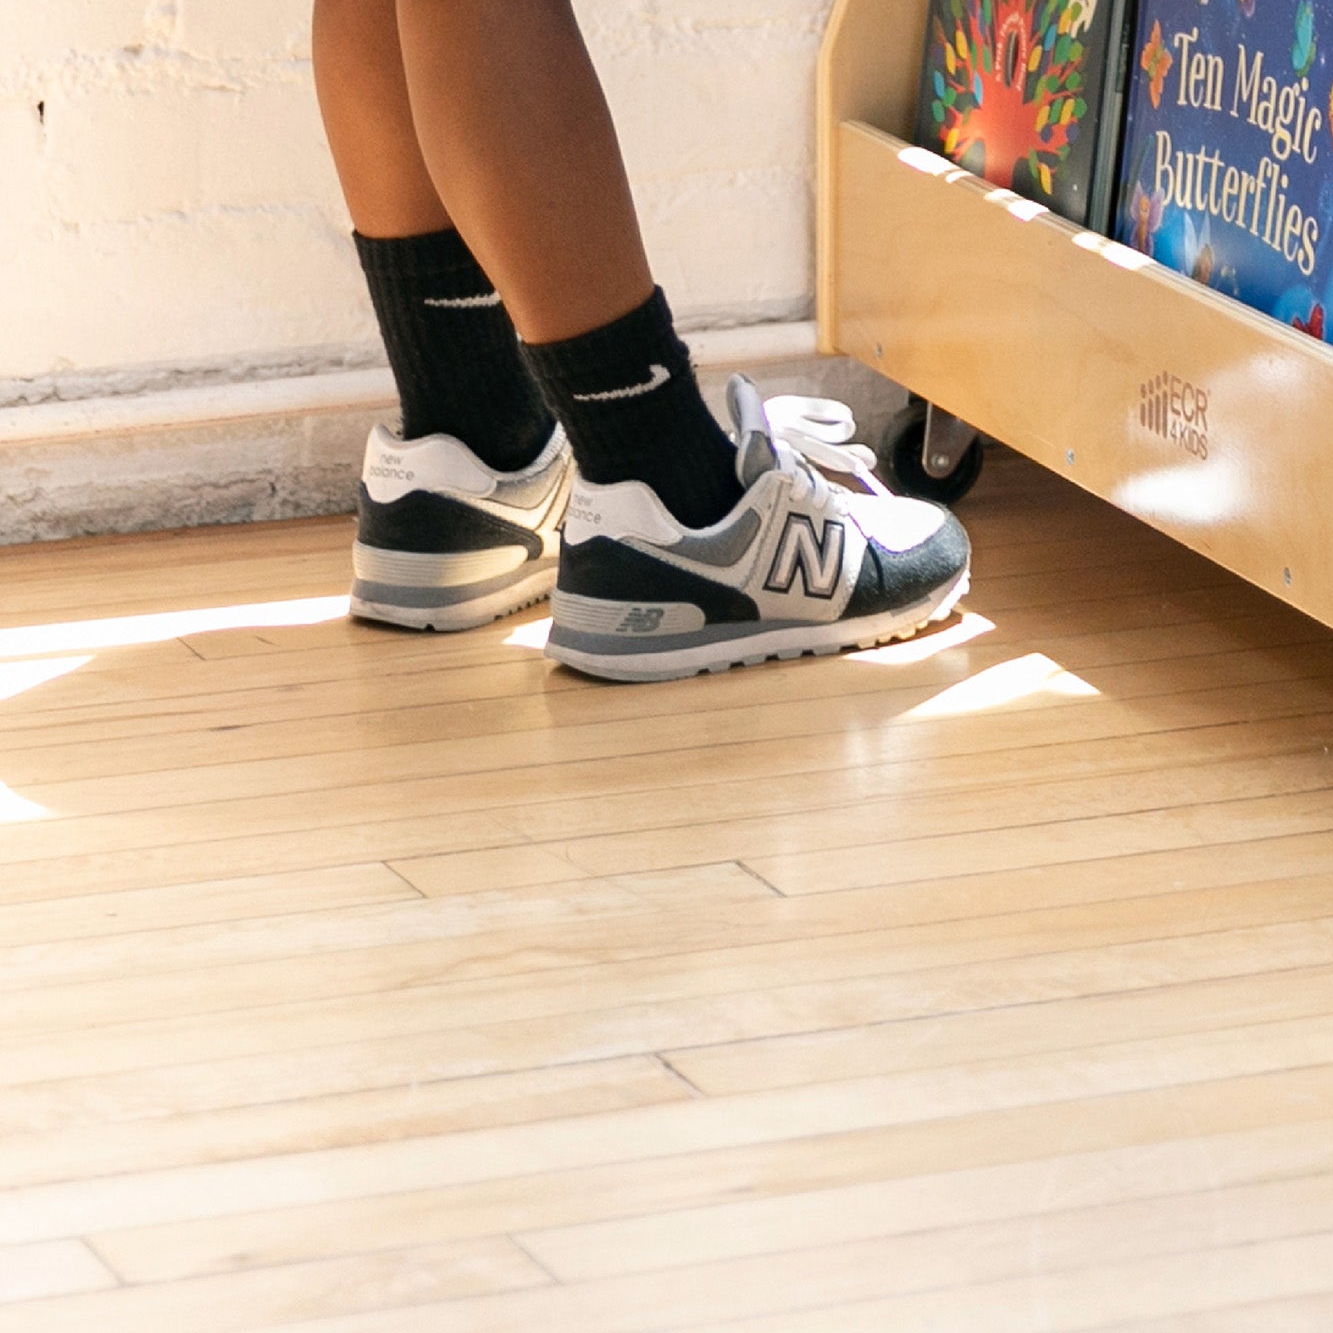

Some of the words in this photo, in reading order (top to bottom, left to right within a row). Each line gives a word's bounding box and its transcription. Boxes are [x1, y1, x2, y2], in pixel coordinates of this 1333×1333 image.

[1173, 26, 1225, 111] Ten
[1229, 43, 1322, 165] Magic
[1155, 130, 1319, 277] Butterflies
[1170, 375, 1208, 431] ECR
[761, 510, 846, 601] N
